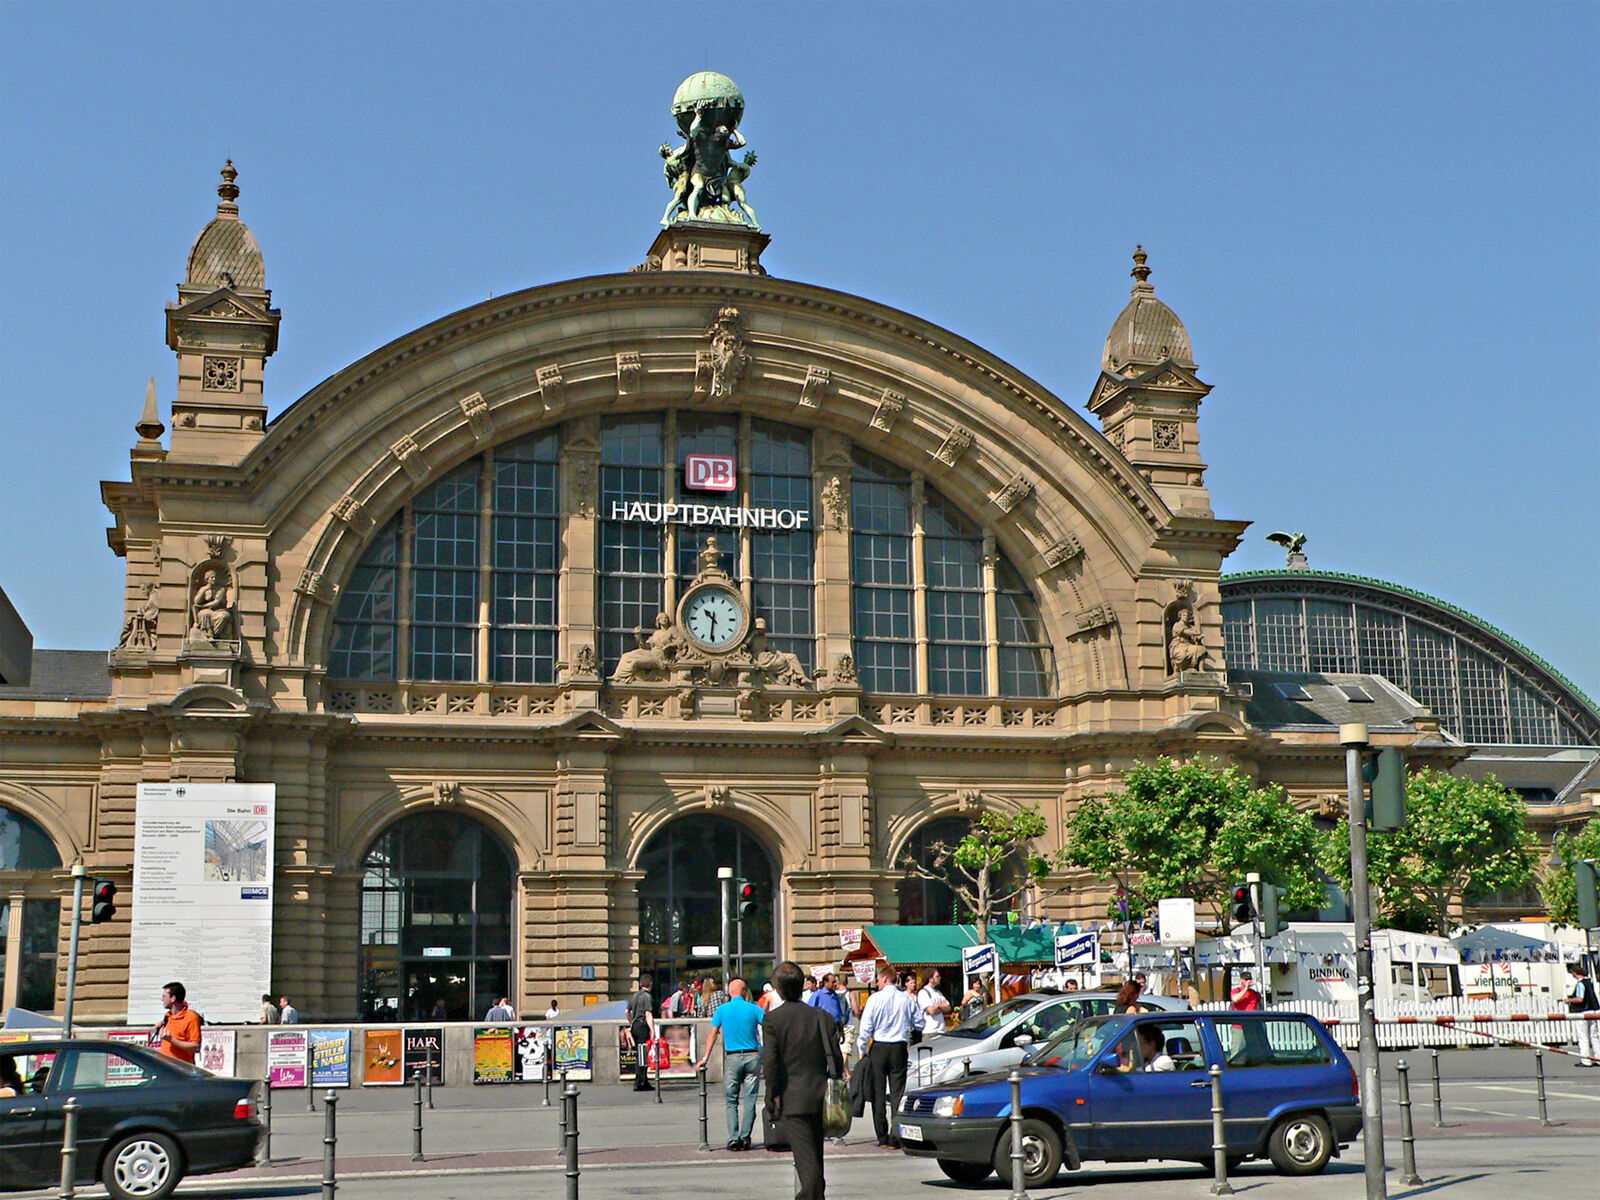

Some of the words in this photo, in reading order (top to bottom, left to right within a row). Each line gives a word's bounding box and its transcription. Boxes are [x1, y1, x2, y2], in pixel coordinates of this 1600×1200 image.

[692, 460, 730, 484] DB
[611, 500, 809, 529] HAUPTBAHNHOF
[1309, 967, 1349, 979] BINDING
[313, 1046, 346, 1060] STILLS
[321, 1053, 347, 1068] NASH
